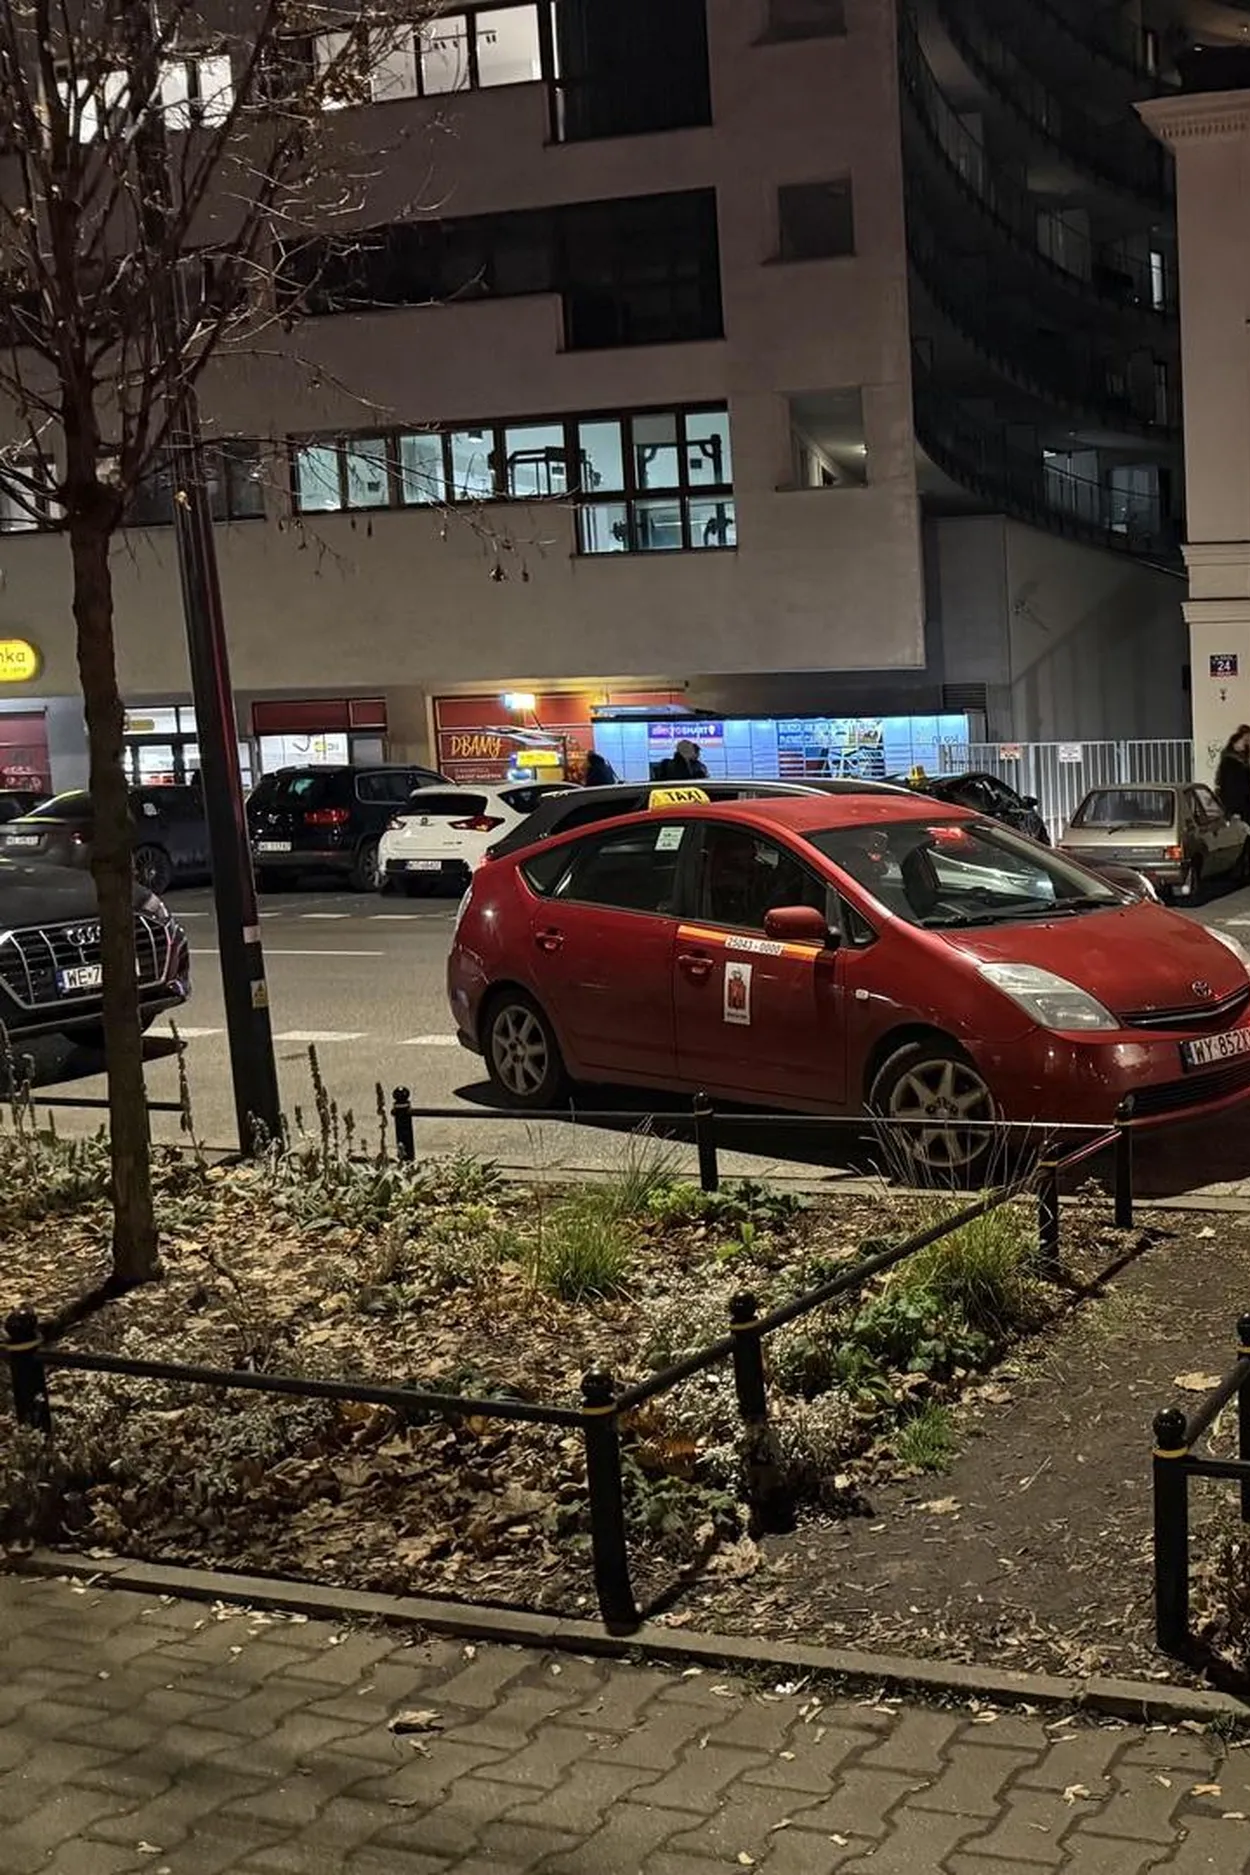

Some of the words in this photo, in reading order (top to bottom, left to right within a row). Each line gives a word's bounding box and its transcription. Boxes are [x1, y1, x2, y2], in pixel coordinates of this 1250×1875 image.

[1217, 660, 1231, 671] 24
[451, 735, 500, 757] DBAMY
[664, 790, 702, 802] TAXI
[67, 968, 88, 986] WE
[1193, 1040, 1213, 1063] WY
